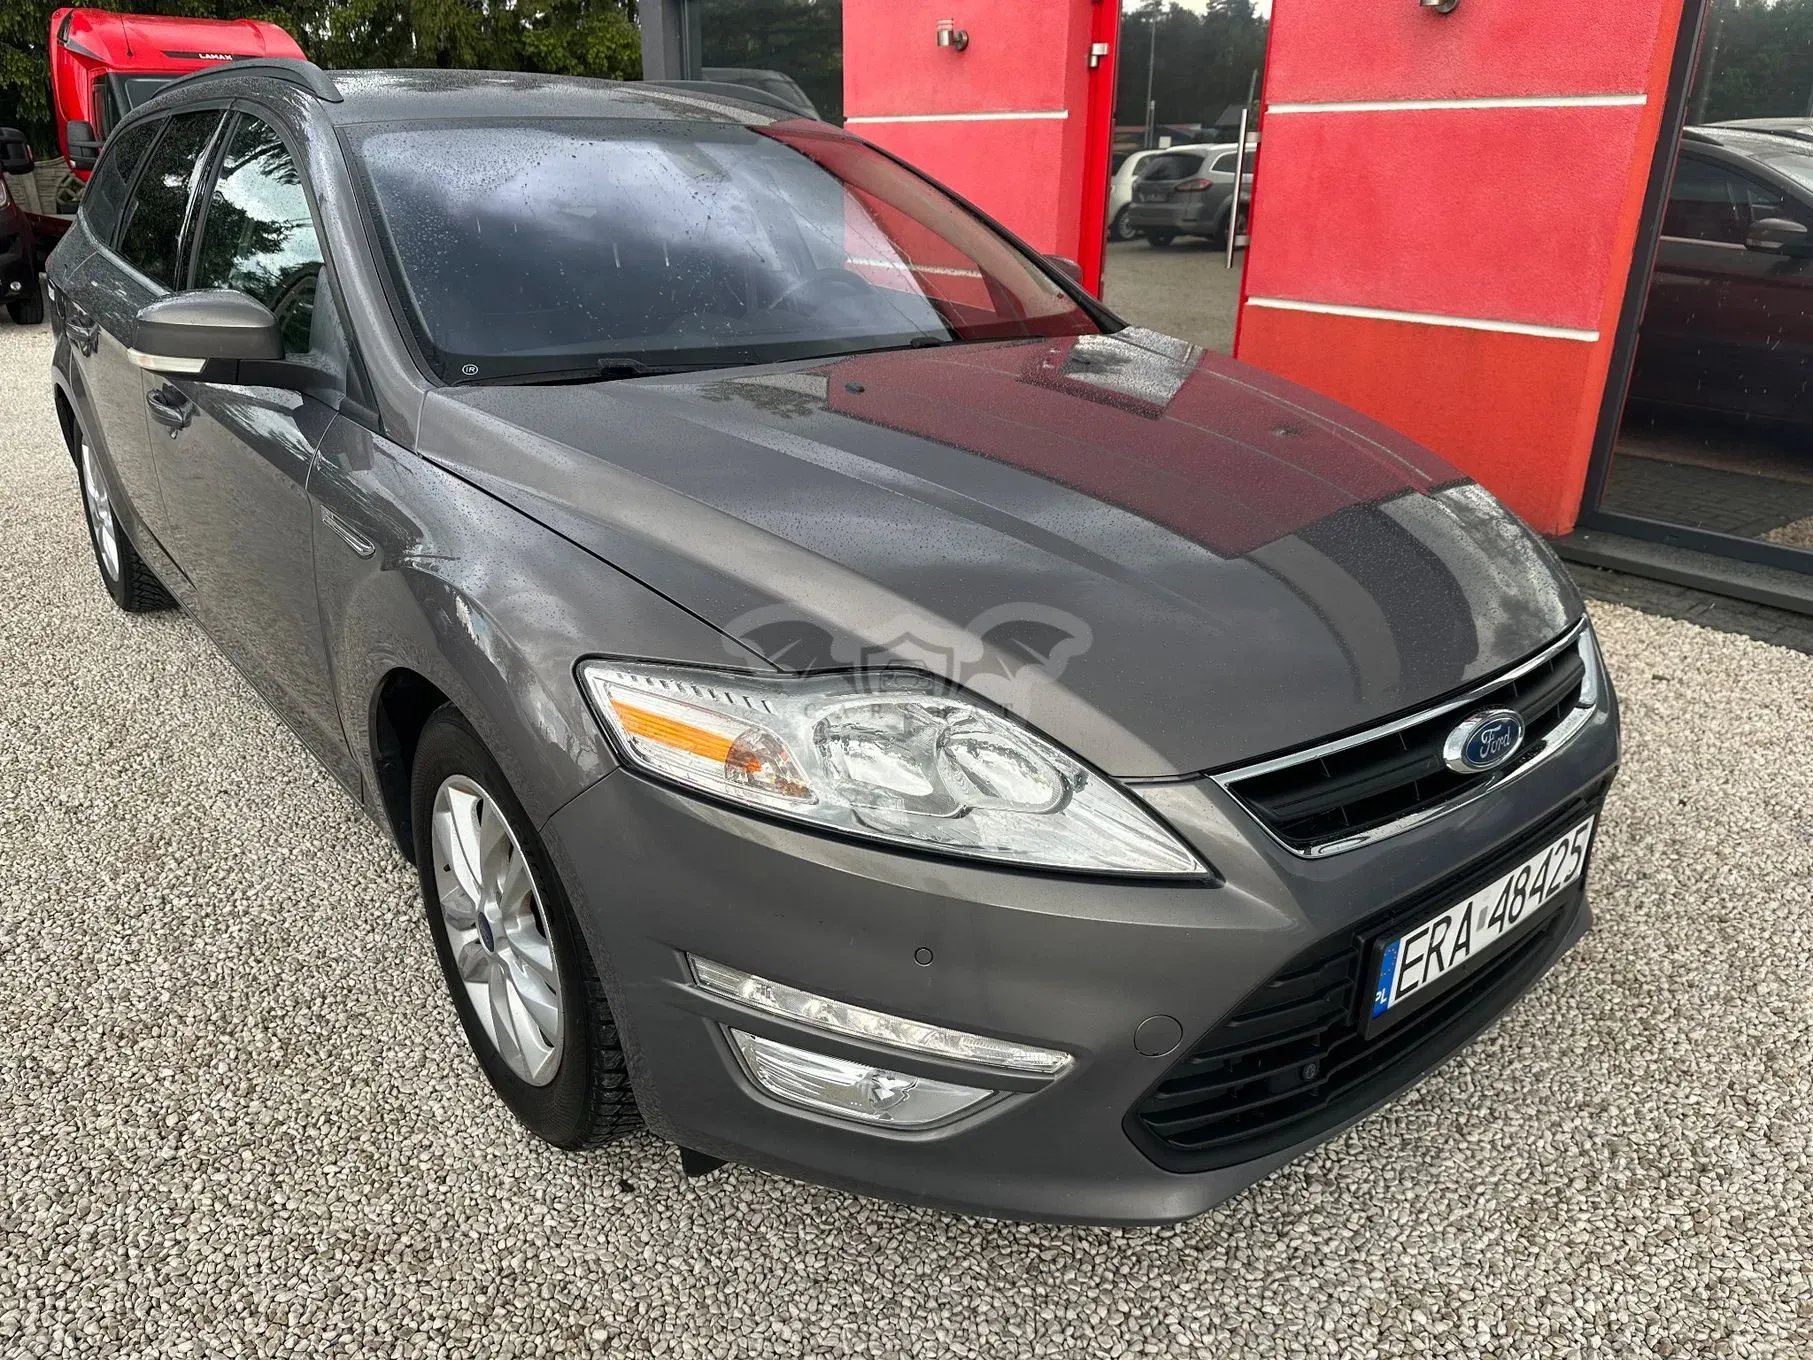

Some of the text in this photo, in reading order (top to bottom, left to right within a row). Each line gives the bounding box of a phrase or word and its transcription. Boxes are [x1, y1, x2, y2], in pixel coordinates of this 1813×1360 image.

[198, 53, 233, 61] LAMAX
[1480, 724, 1512, 759] Ford
[1394, 822, 1590, 1001] ERA 48425
[1375, 987, 1388, 1005] PL
